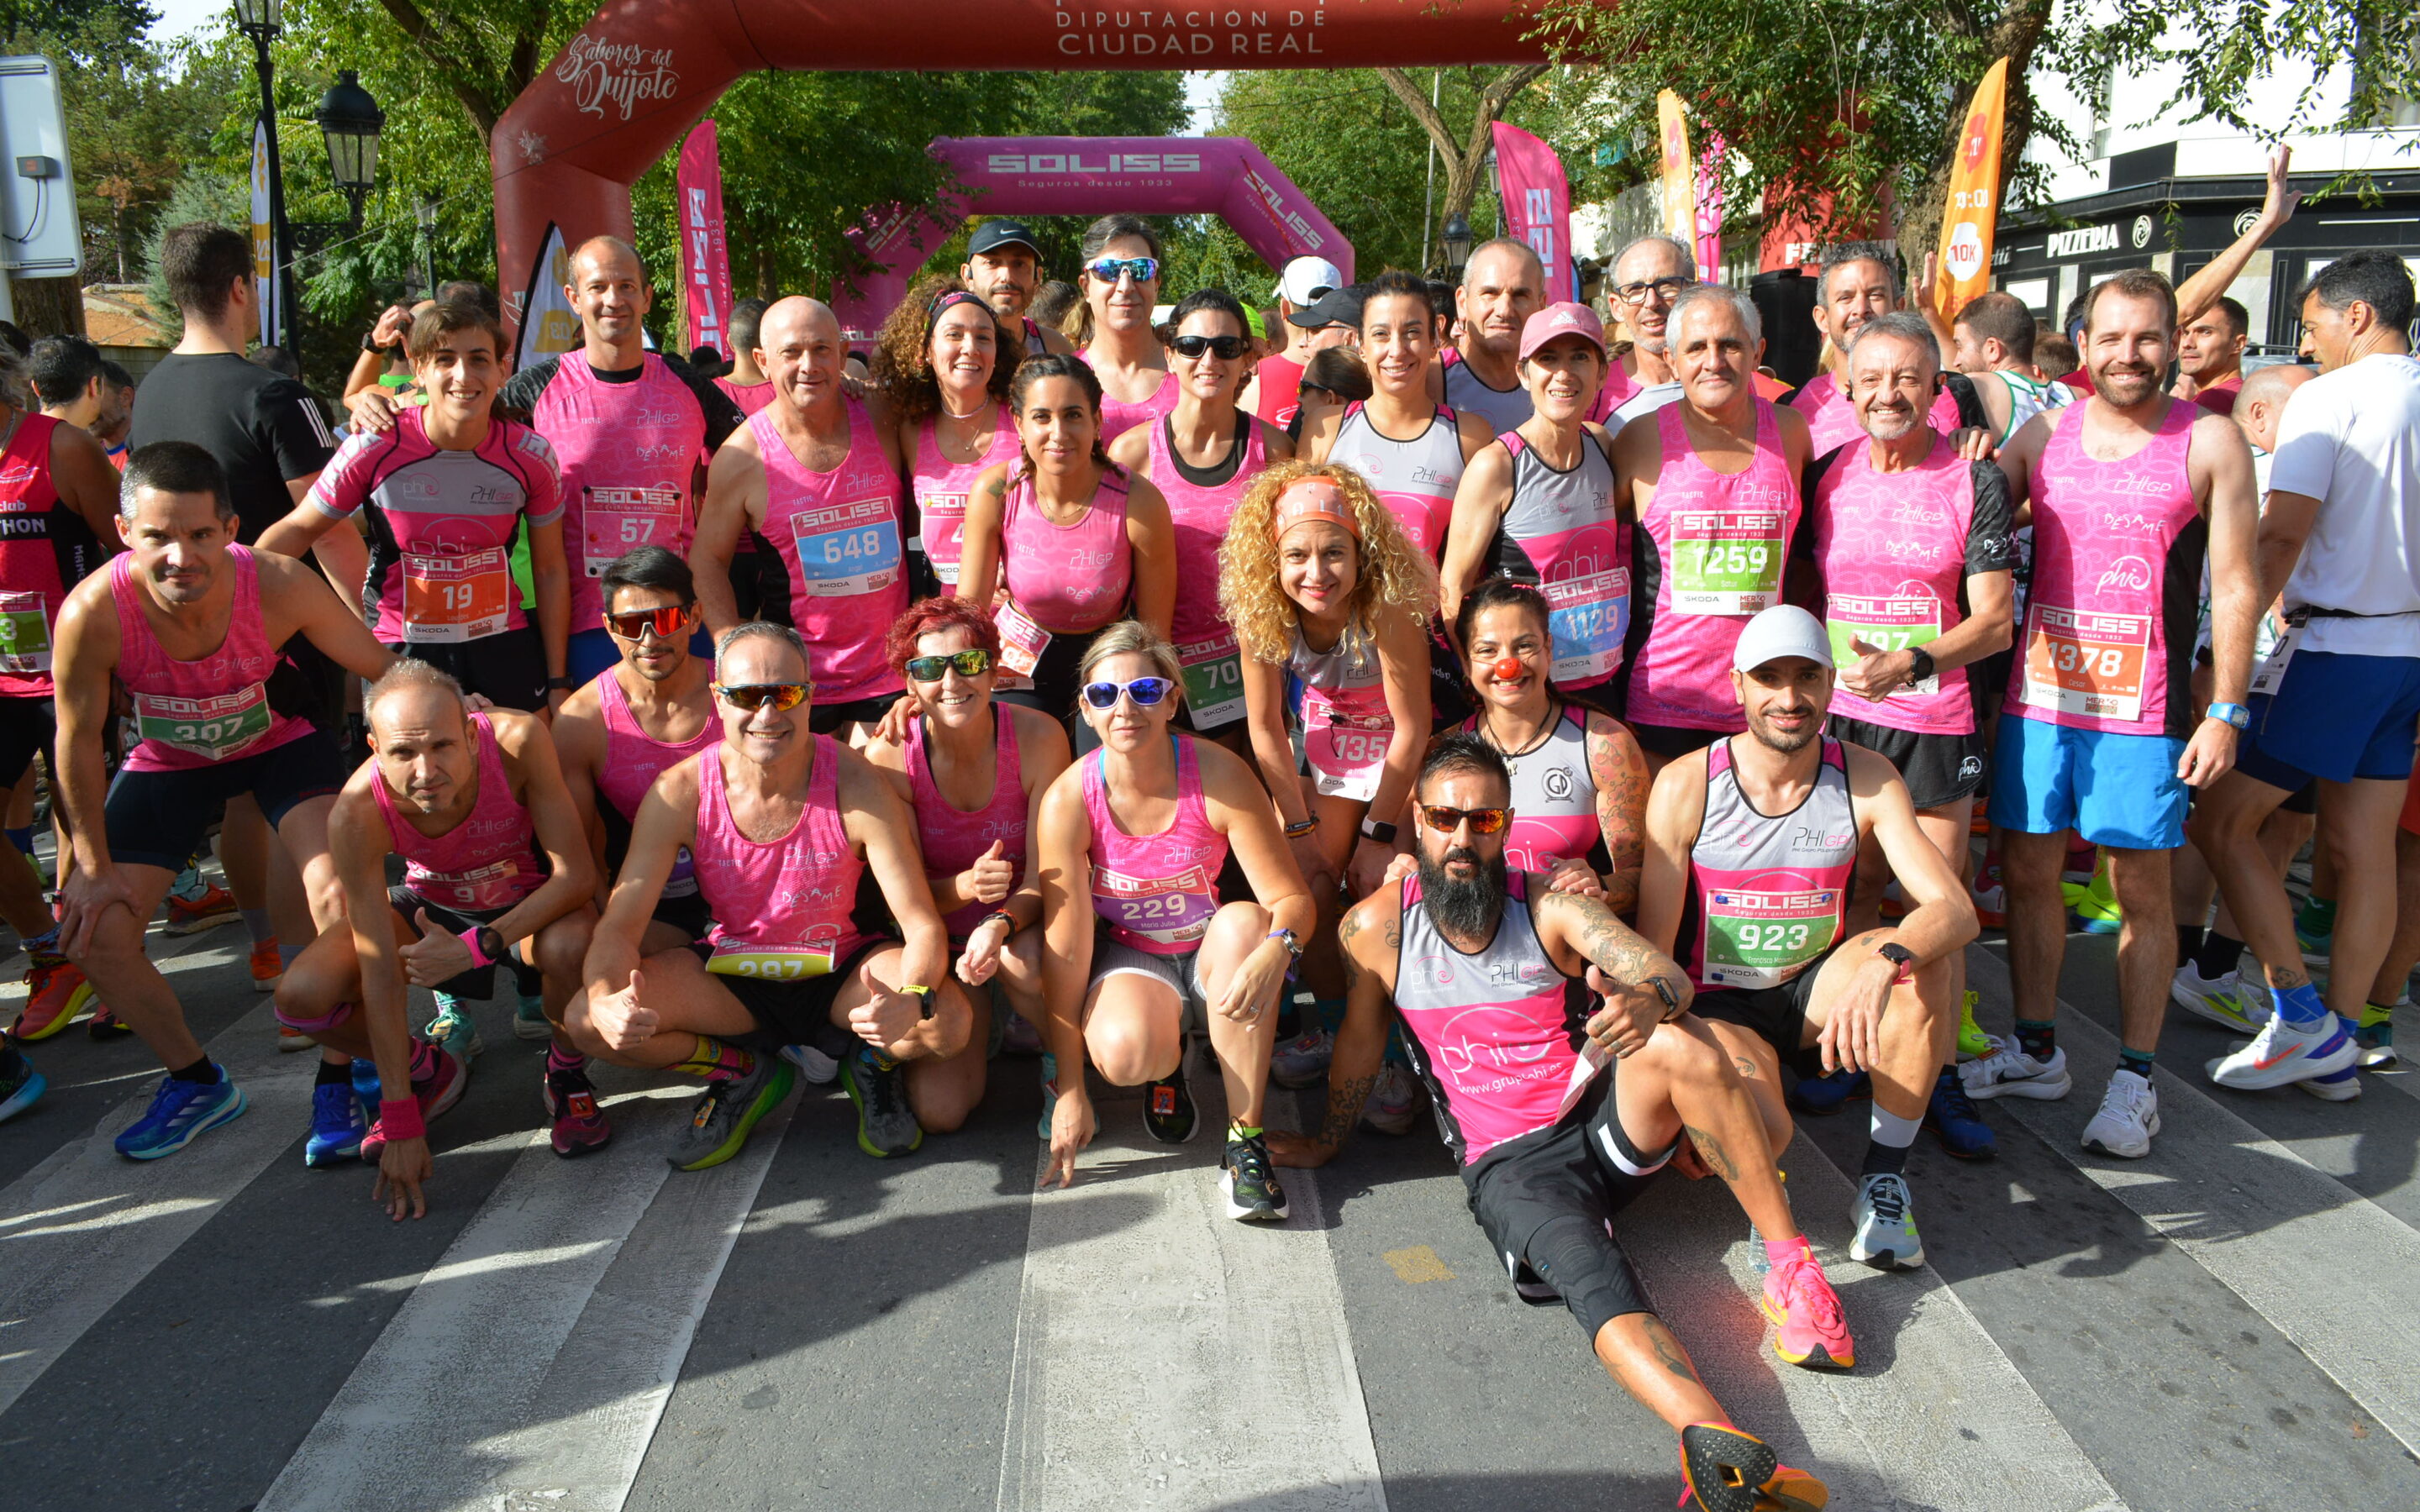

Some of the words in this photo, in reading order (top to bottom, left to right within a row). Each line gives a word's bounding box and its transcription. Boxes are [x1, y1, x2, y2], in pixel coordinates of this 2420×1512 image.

[1056, 10, 1266, 28] DIPUTACIÓN
[1289, 10, 1324, 27] DE
[555, 33, 643, 82] Sabores
[650, 49, 673, 67] del
[1058, 34, 1214, 55] CIUDAD
[1231, 33, 1323, 54] REAL
[574, 60, 681, 121] Quijote
[988, 154, 1200, 173] SOLISS
[1018, 180, 1080, 189] Seguros
[1087, 179, 1132, 187] desde
[1950, 244, 1976, 263] 10K
[2047, 223, 2120, 258] PIZZERIA
[802, 501, 885, 528] SOLISS
[1683, 516, 1777, 530] SOLISS
[620, 518, 655, 543] 57
[823, 530, 881, 564] 648
[1693, 545, 1769, 575] 1259
[412, 551, 499, 572] SOLISS
[442, 583, 473, 611] 19
[1548, 574, 1625, 601] SOLISS
[1837, 598, 1930, 617] SOLISS
[1565, 605, 1618, 641] 1129
[2042, 609, 2139, 635] SOLISS
[2047, 642, 2123, 677] 1378
[1202, 660, 1239, 690] 70
[149, 687, 256, 714] SOLISS
[175, 717, 245, 743] 307
[1335, 735, 1388, 763] 135
[410, 859, 505, 882] SOLISS
[1101, 872, 1198, 892] SOLISS
[1121, 894, 1187, 921] 229
[1738, 924, 1809, 951] 923
